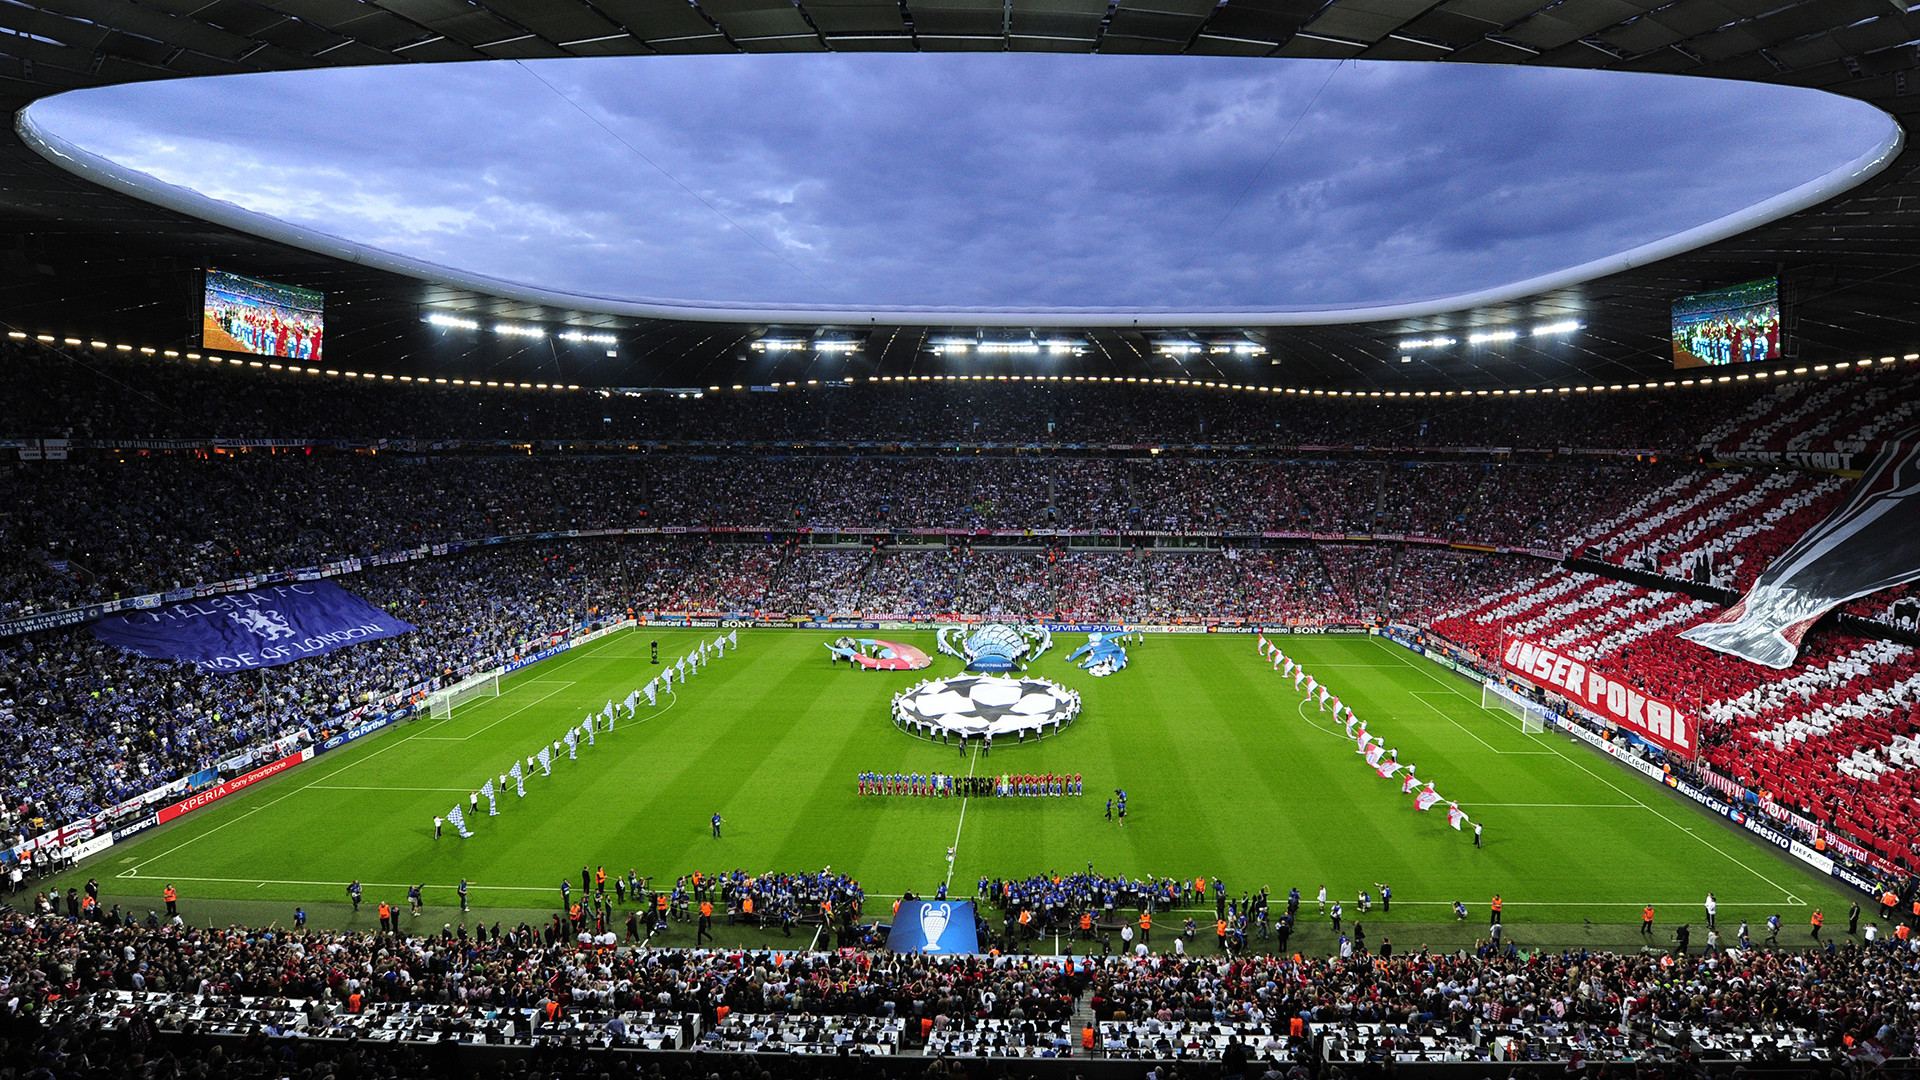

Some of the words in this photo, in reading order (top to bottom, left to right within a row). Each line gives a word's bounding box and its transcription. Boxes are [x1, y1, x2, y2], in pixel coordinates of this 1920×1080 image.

[273, 583, 315, 598] FC
[24, 622, 56, 632] WHITE
[60, 615, 85, 625] ARMY
[721, 620, 755, 628] SONY
[1133, 625, 1163, 633] UniCredit
[1174, 625, 1204, 633] UniCredit
[1217, 626, 1253, 634] MasterCard
[1263, 626, 1288, 634] Maestro
[1293, 626, 1327, 634] SONY
[1328, 627, 1367, 635] make.believe
[260, 644, 291, 660] OF
[292, 623, 384, 653] LONDON
[1504, 639, 1586, 696] UNSER
[1588, 671, 1690, 750] POKAL
[348, 728, 360, 739] Go
[360, 717, 387, 736] Further
[1573, 723, 1604, 747] UniCredit
[1615, 745, 1651, 773] UniCredit
[231, 778, 248, 790] Sony
[248, 761, 287, 781] Smartphone
[179, 786, 226, 813] XPERIA
[1676, 781, 1729, 816] MasterCard
[120, 817, 157, 838] RESPECT
[1744, 818, 1789, 849] Maestro
[71, 836, 112, 858] EFA.com
[1839, 870, 1877, 895] RESPECT
